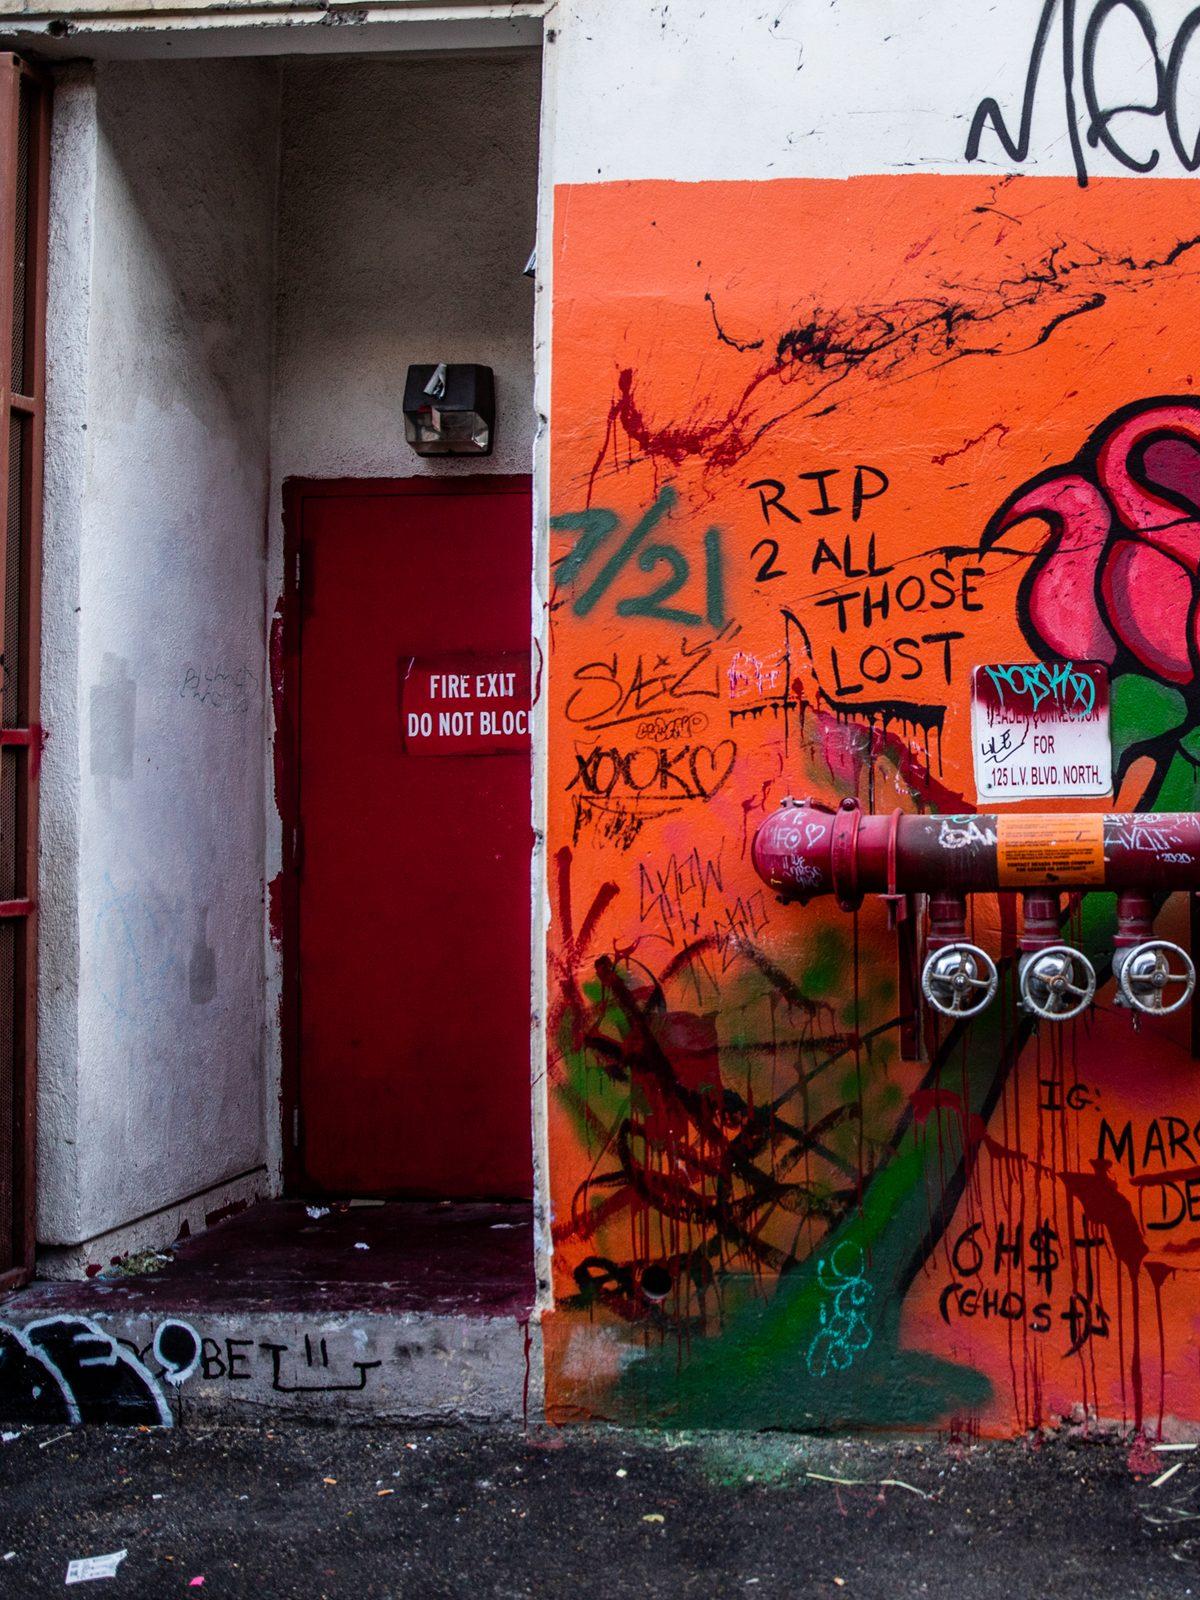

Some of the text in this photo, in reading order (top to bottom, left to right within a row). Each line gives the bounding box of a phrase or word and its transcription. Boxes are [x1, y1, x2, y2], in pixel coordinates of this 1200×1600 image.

[746, 465, 889, 526] RIP
[549, 486, 725, 627] 7/21
[750, 531, 895, 582] 2 ALL
[814, 567, 985, 633] THOSE
[429, 673, 516, 699] FIRE EXIT
[830, 631, 965, 696] LOST
[407, 712, 433, 737] DO
[438, 711, 474, 736] NOT
[1033, 735, 1055, 754] FOR
[991, 766, 1100, 787] 125 L.V. BLVD. NORTH
